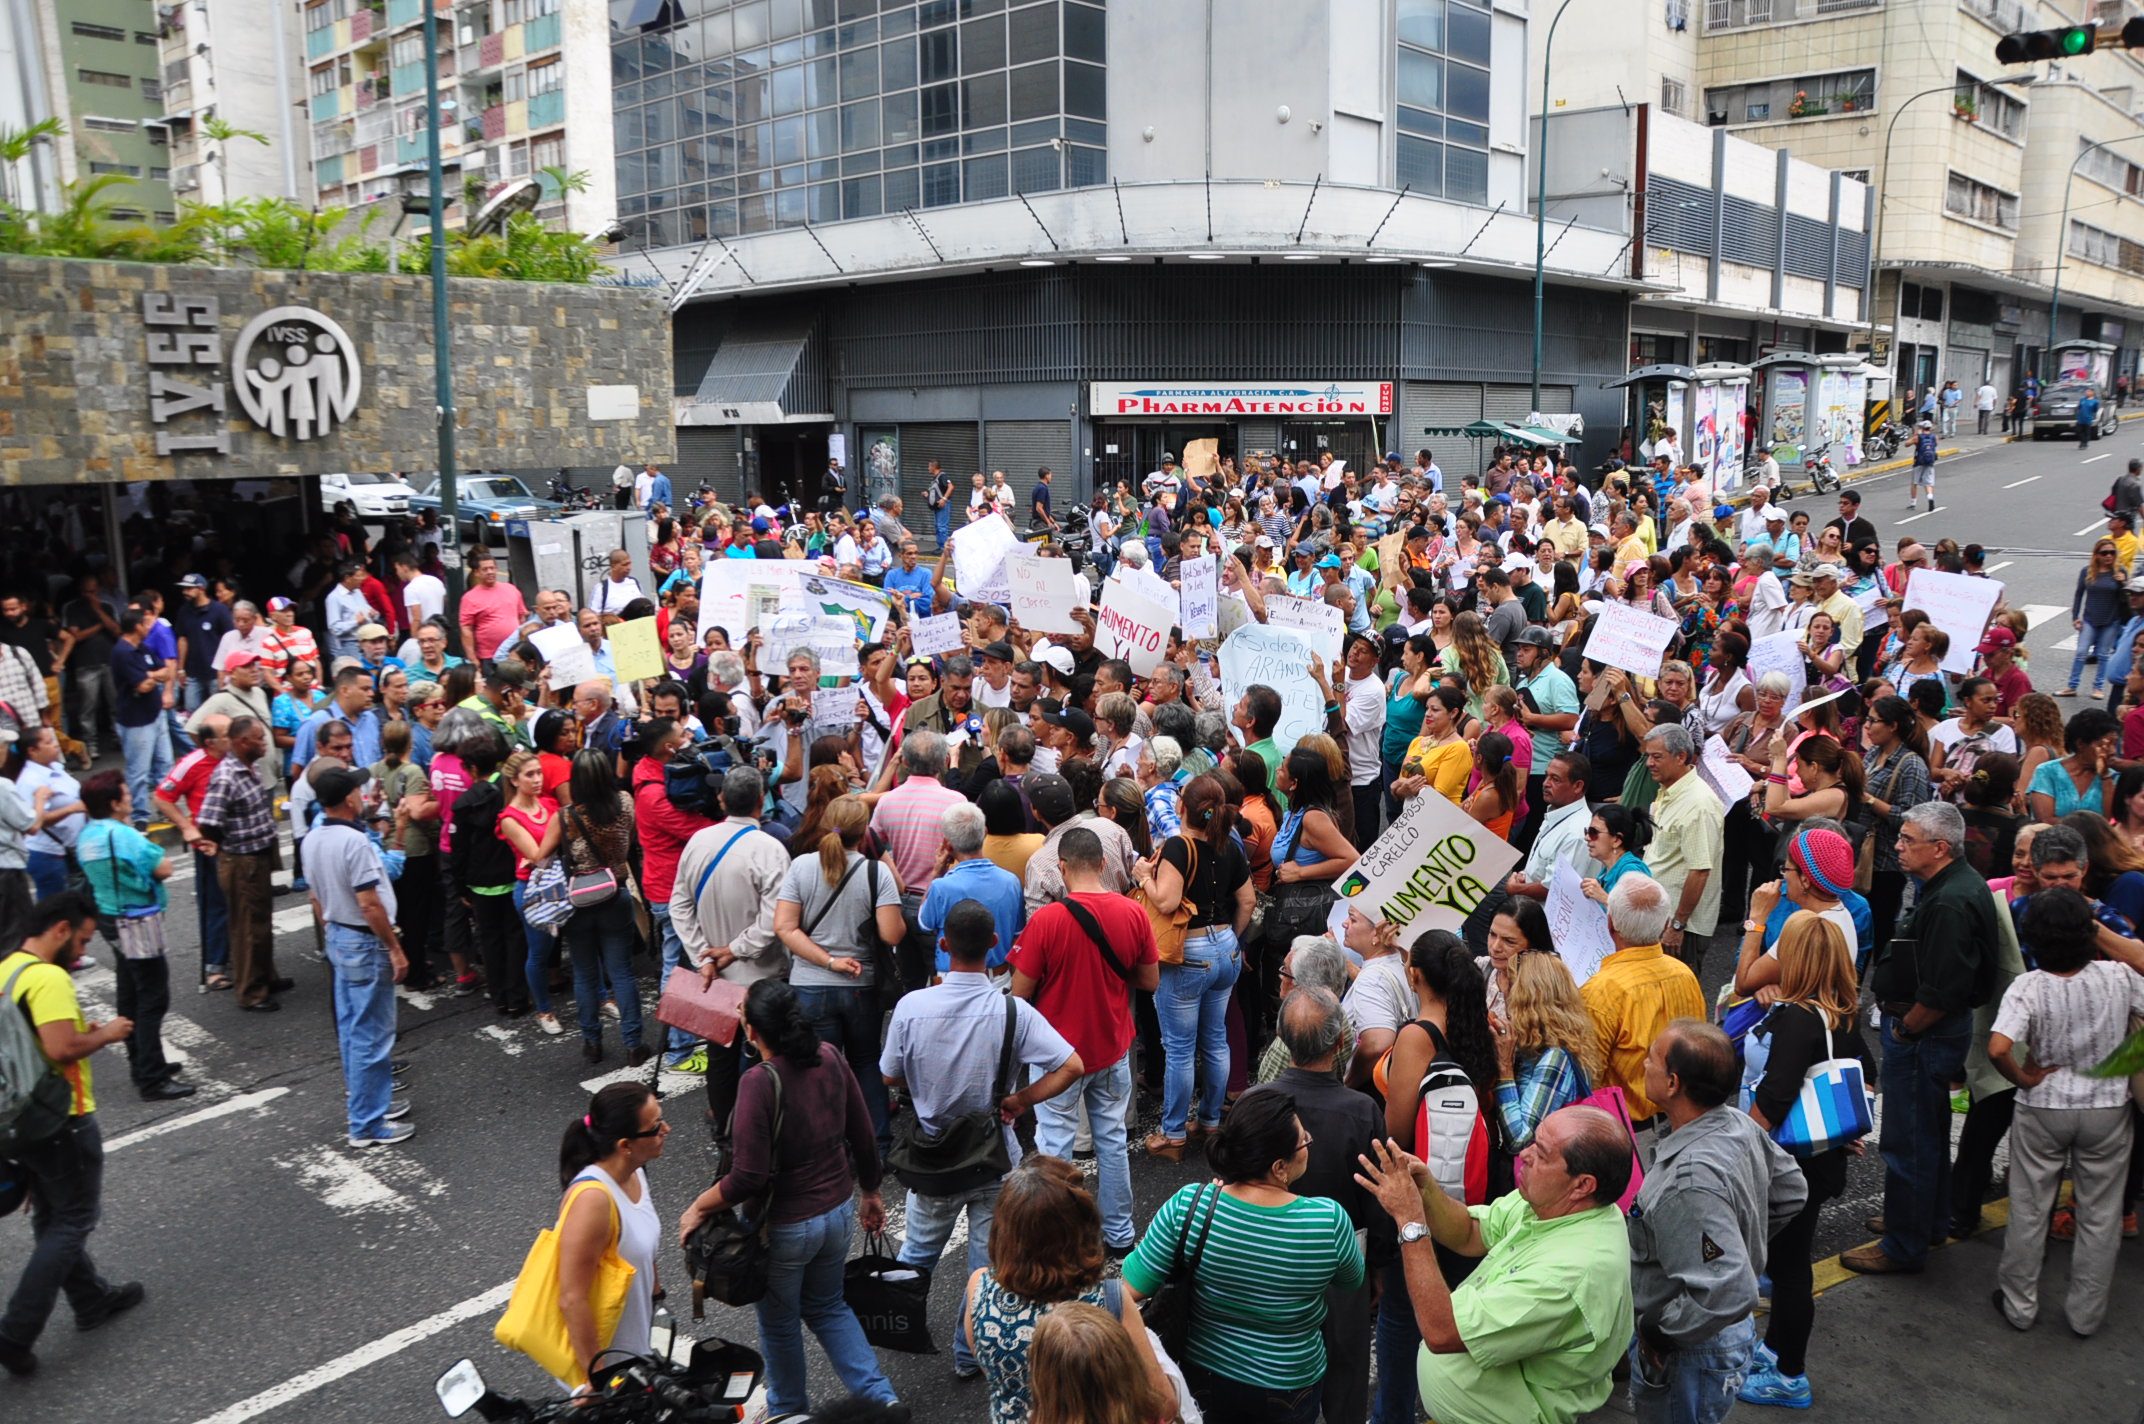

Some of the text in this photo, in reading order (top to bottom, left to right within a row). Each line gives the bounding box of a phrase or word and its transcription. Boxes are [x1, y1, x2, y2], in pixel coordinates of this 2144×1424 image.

[267, 326, 309, 343] IVSS
[1382, 385, 1391, 412] TURNO
[1016, 567, 1031, 579] NO
[1035, 581, 1048, 592] AL
[977, 590, 1011, 601] SOS
[1099, 604, 1161, 653] AUMENTO
[1112, 635, 1132, 662] YA
[1360, 795, 1426, 867] CASA DE REPOSO
[1371, 826, 1420, 878] CARELCO
[1379, 833, 1477, 934] AUMENTO
[1434, 875, 1491, 918] YA
